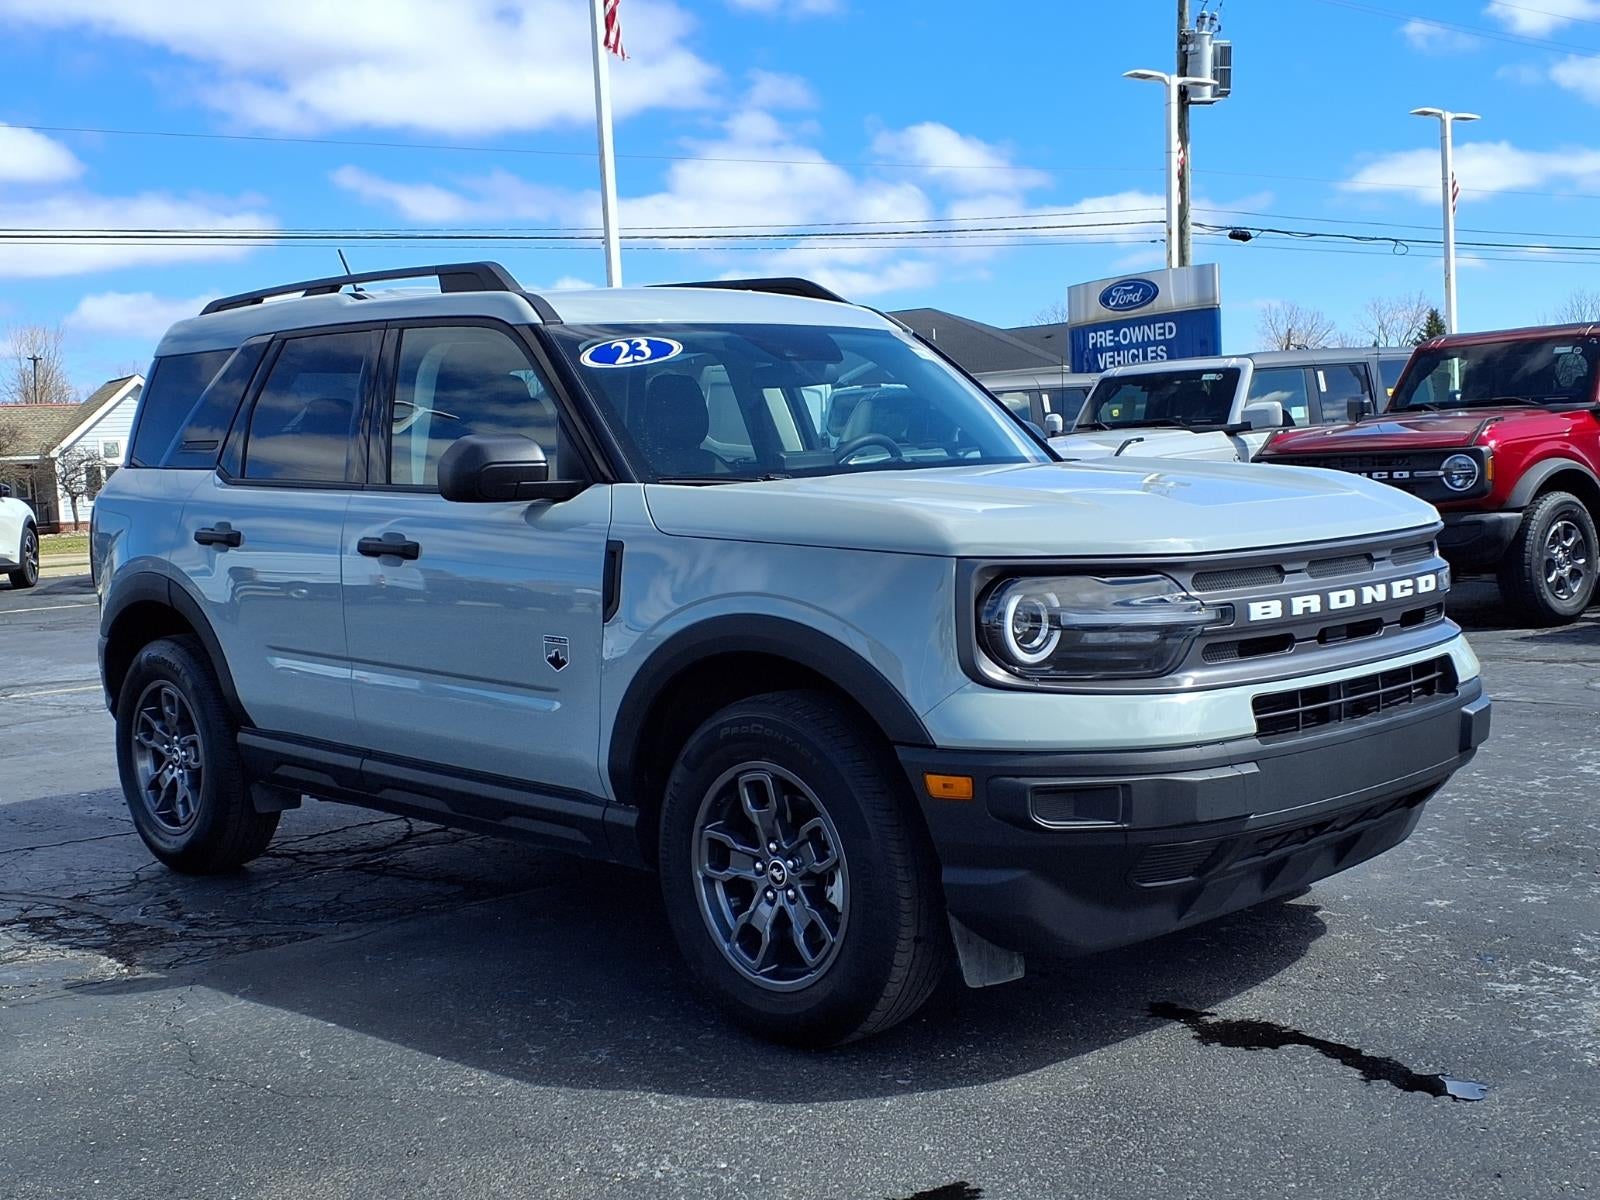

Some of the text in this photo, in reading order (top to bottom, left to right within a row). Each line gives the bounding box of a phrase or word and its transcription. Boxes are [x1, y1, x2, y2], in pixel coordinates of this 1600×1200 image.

[1109, 285, 1143, 306] Ford
[1088, 321, 1177, 349] PRE-OWNED
[611, 339, 652, 365] 23
[1097, 345, 1167, 370] VEHICLES
[1248, 573, 1436, 621] BRONCO
